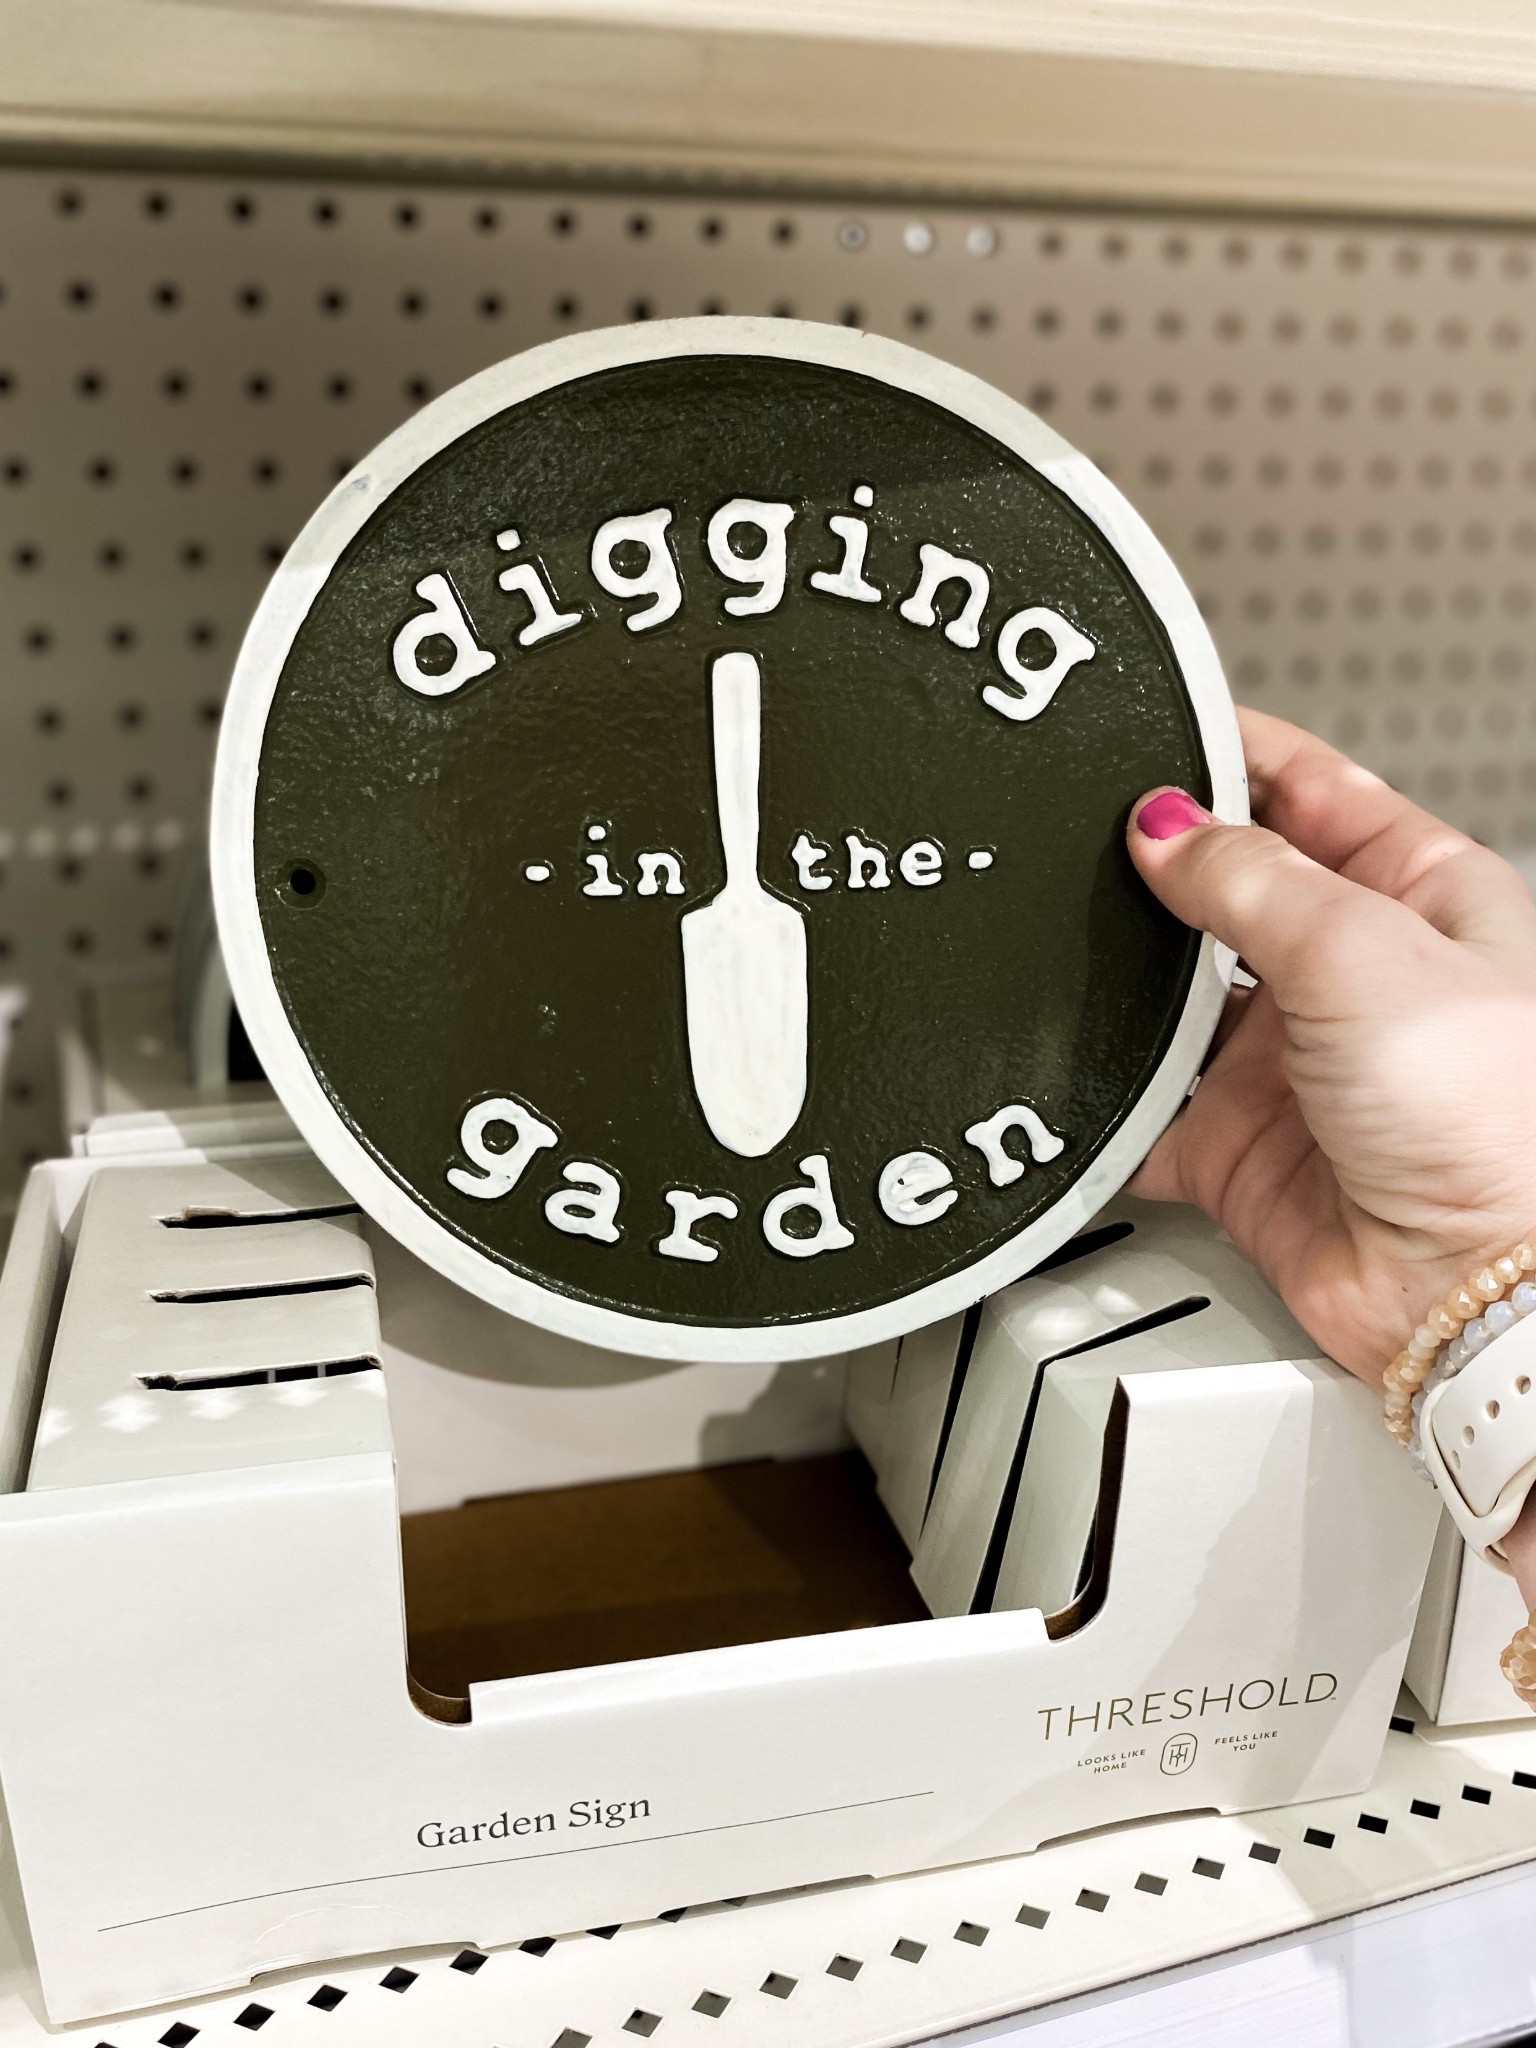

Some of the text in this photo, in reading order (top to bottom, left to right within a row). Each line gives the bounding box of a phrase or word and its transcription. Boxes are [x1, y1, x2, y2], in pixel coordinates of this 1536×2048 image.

[391, 485, 1096, 722] digging
[581, 825, 686, 897] in
[791, 833, 944, 890] the
[446, 1096, 1065, 1264] garden
[1037, 1672, 1338, 1741] THRESHOLD
[1077, 1749, 1146, 1767] LOOKS LIKE
[1214, 1731, 1278, 1745] FEELS LIKE
[1233, 1743, 1256, 1752] YOU
[1093, 1762, 1127, 1774] HOME
[416, 1799, 652, 1848] Garden Sign
